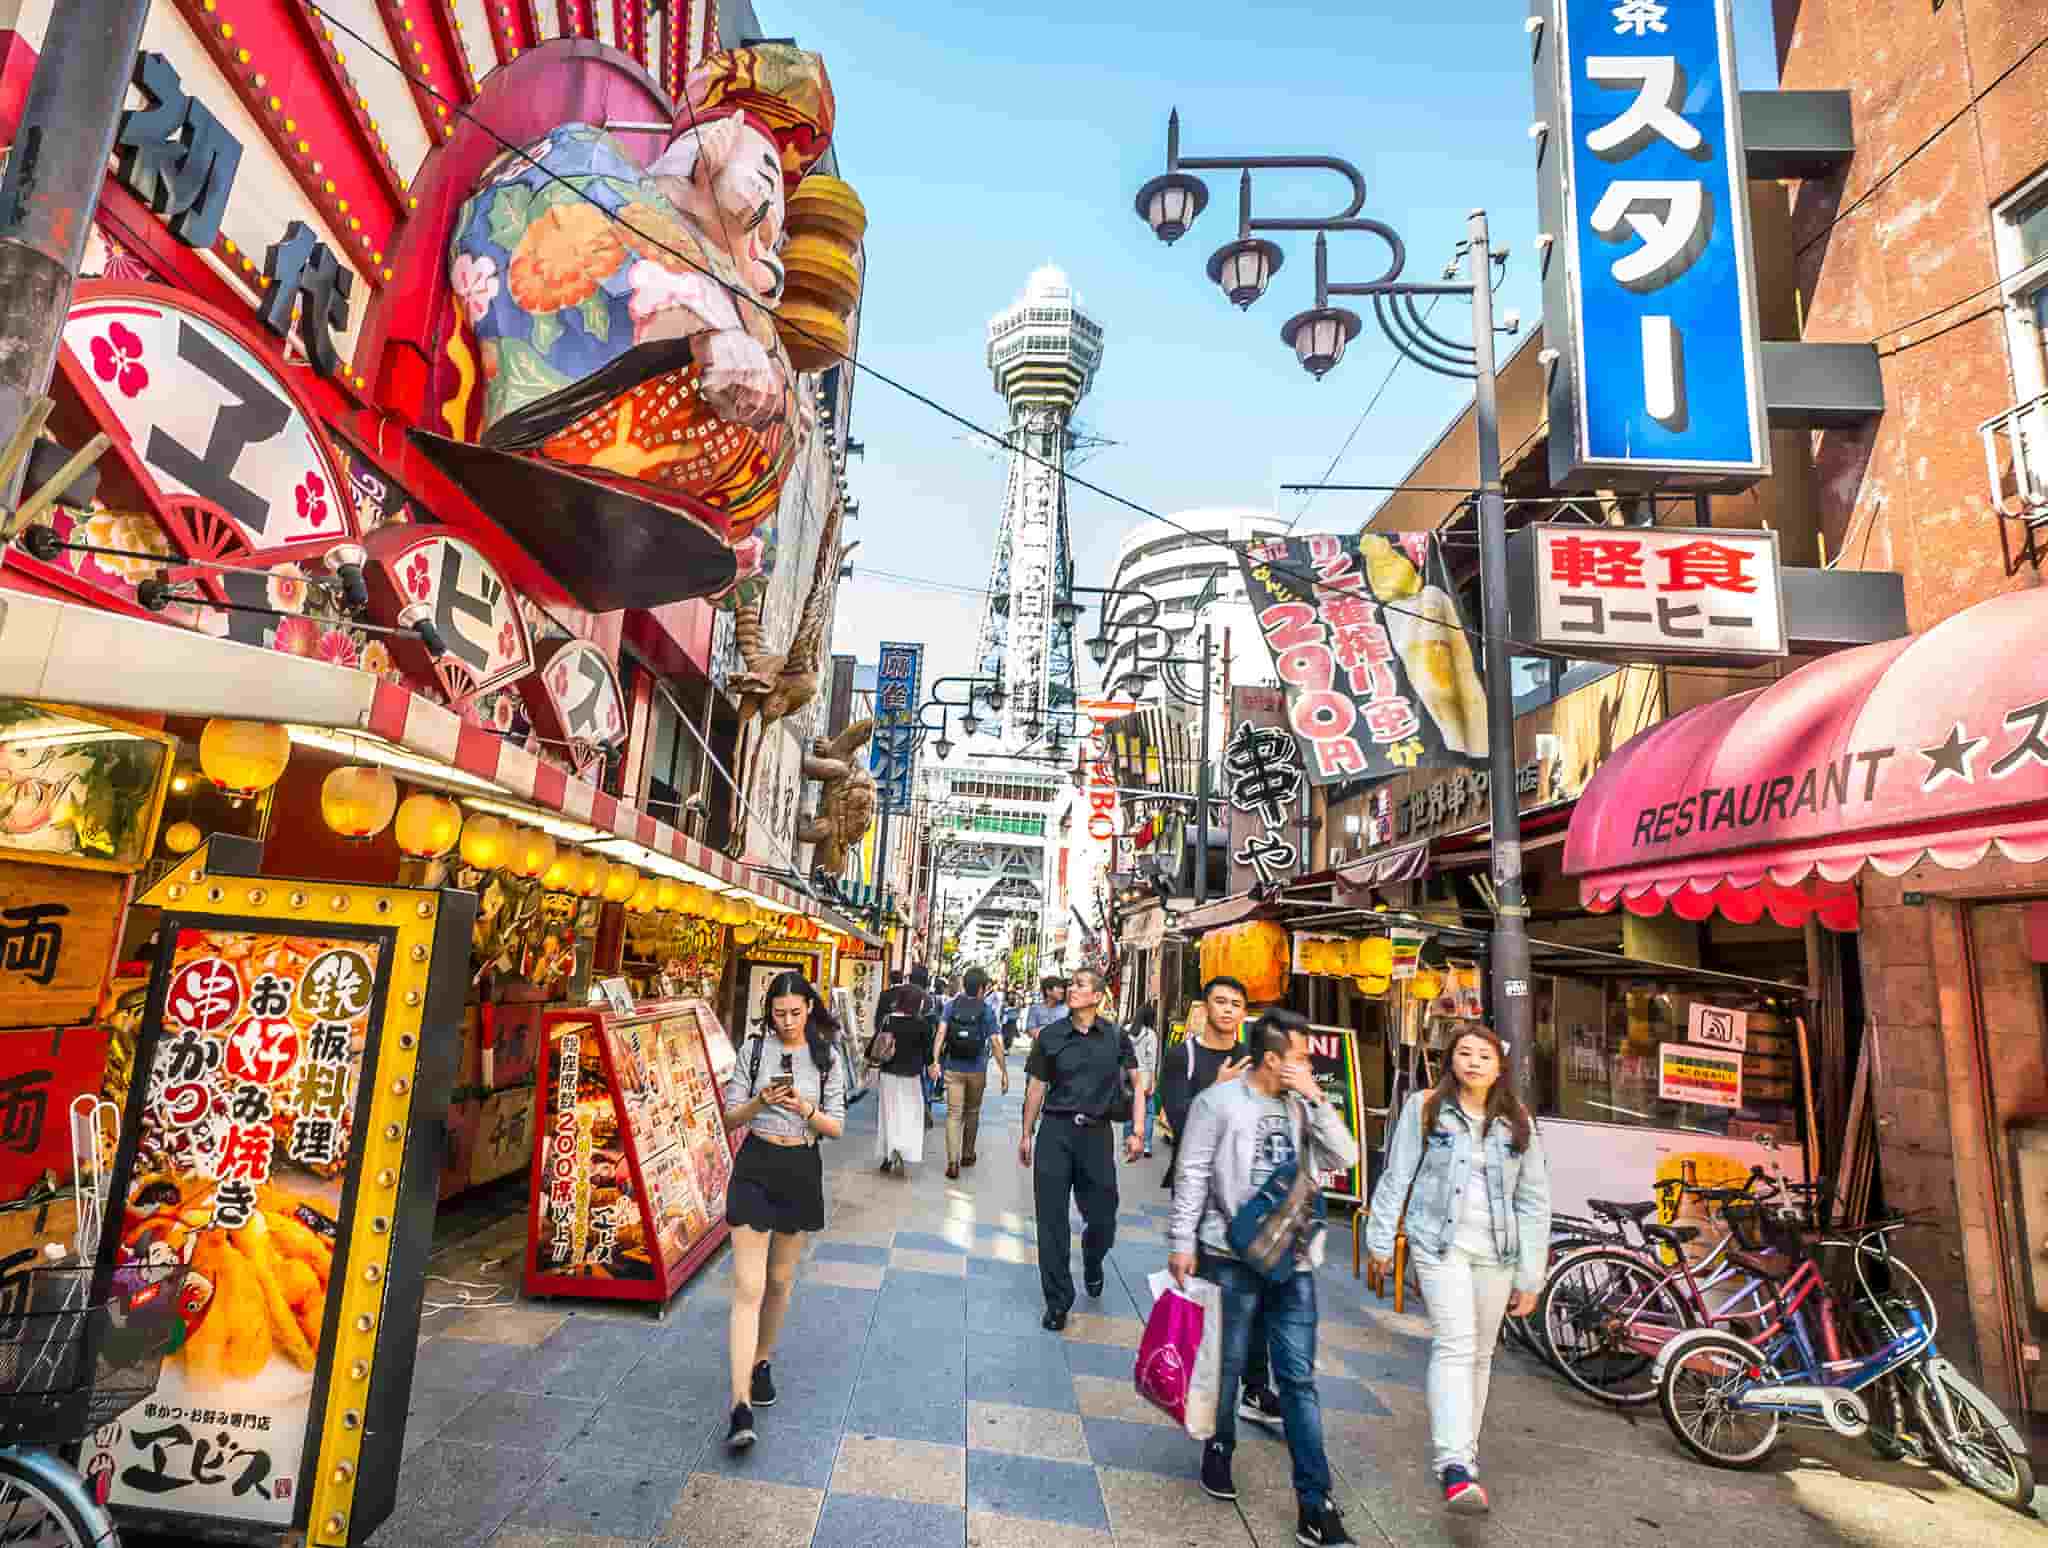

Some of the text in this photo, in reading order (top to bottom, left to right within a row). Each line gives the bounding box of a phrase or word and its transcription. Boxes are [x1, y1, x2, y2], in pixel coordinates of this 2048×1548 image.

[1584, 54, 1704, 421] スター
[1550, 535, 1757, 594] 軽食
[1560, 594, 1754, 638] コーヒー
[1632, 747, 1896, 848] RESTAURANT
[159, 957, 236, 1128] 串かつ
[215, 973, 296, 1228] お好み焼き
[291, 951, 368, 1163] 鉄板料理
[120, 1423, 273, 1501] エビス
